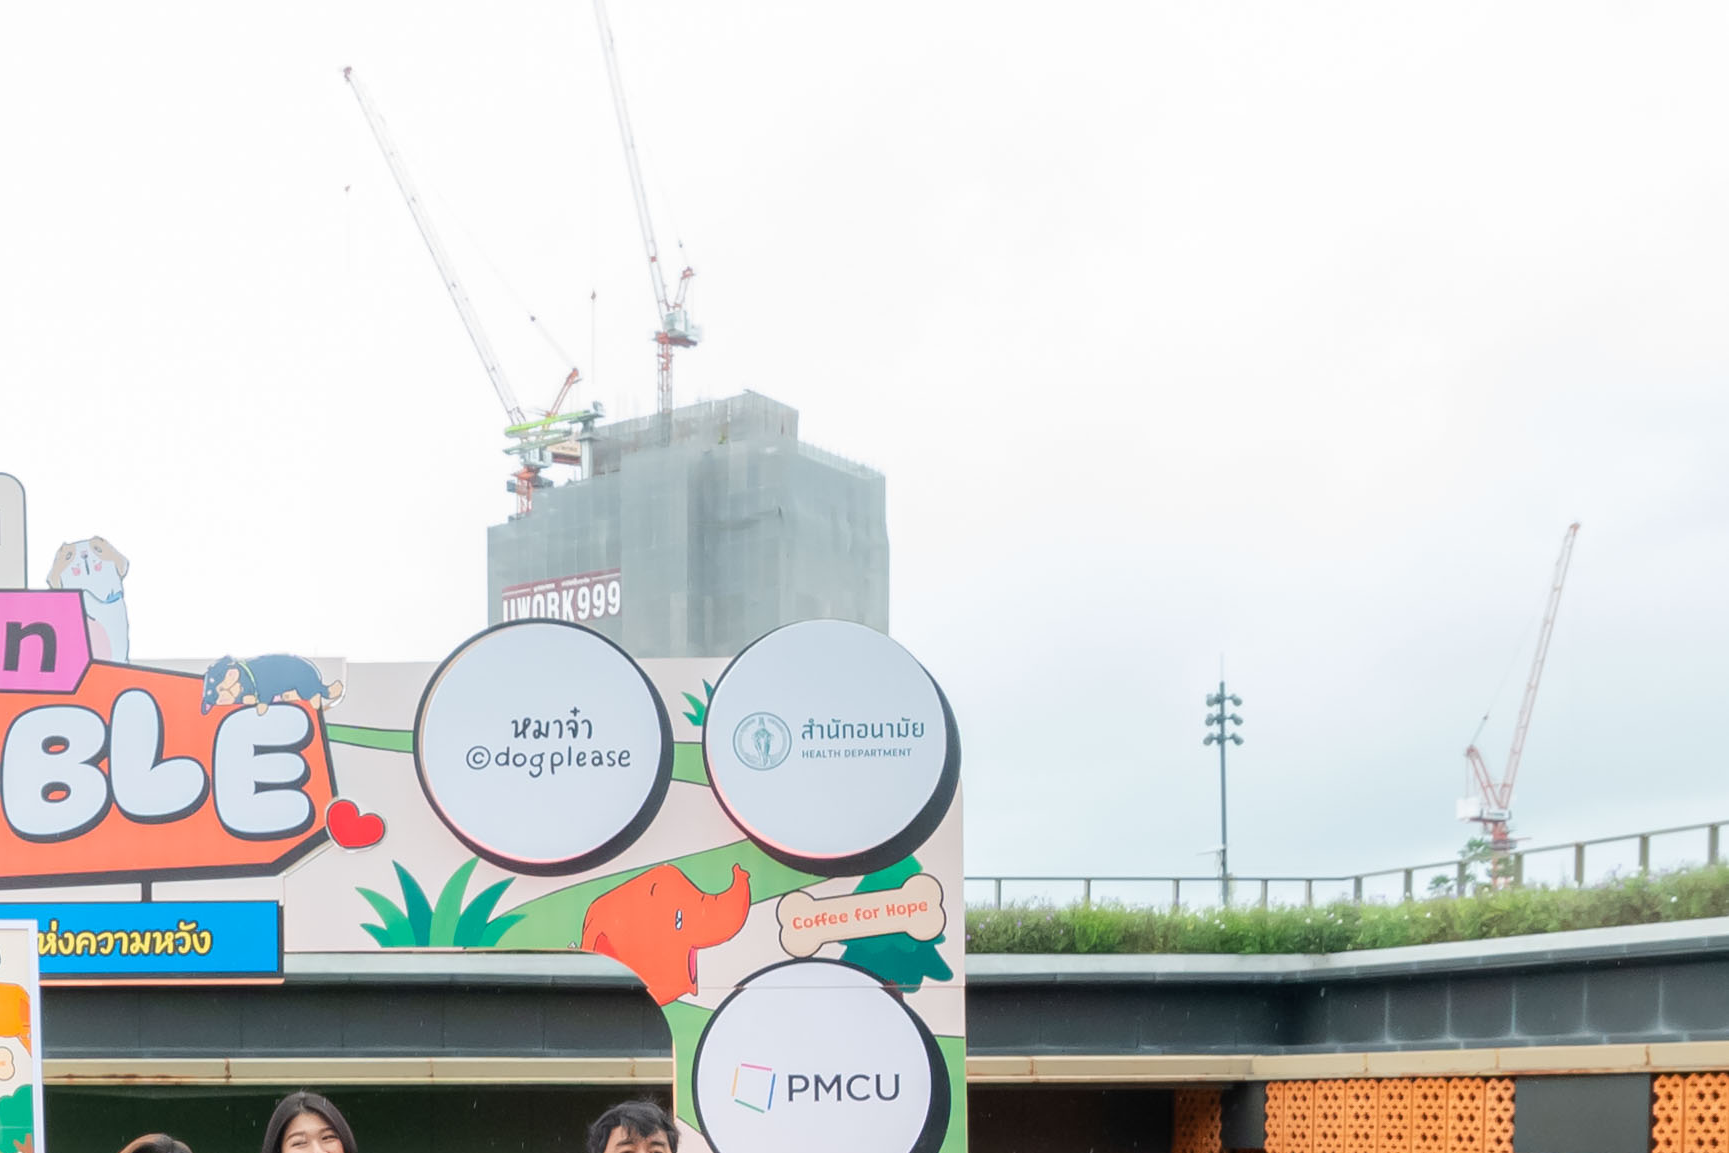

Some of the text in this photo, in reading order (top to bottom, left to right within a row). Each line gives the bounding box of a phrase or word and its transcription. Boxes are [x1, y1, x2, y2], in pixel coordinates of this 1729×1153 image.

[511, 706, 593, 740] หมาจ๋า
[801, 717, 925, 740] สำนักอนามัย
[801, 748, 912, 759] HEALTH DEPARTMENT
[792, 901, 928, 930] Coffee for Hope
[787, 1073, 901, 1102] PMCU
